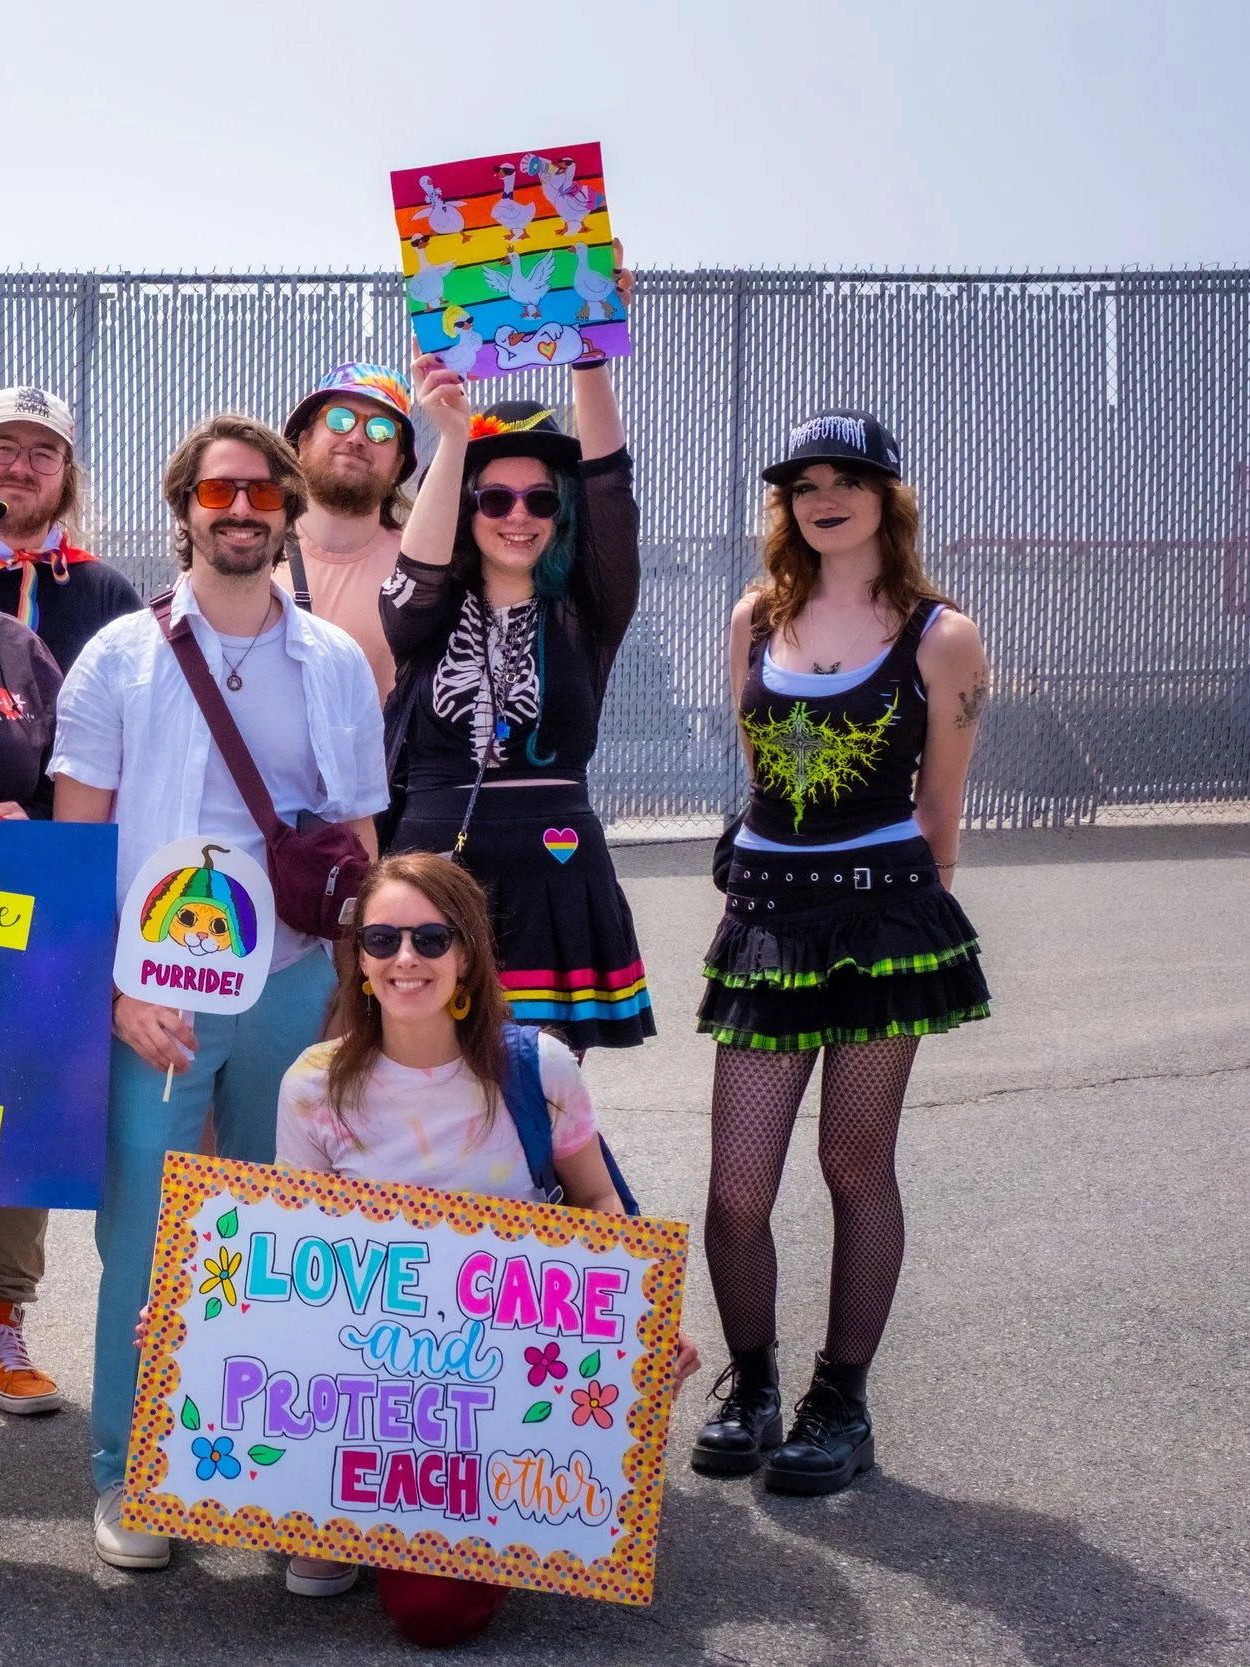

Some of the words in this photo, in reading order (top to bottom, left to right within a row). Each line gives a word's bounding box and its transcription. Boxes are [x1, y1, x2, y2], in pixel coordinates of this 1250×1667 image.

[141, 959, 244, 996] PURRIDE!
[457, 1250, 630, 1344] CARE
[338, 1320, 503, 1382] and
[221, 1355, 496, 1451] PROTECT
[331, 1445, 483, 1521] EACH
[487, 1449, 613, 1526] other
